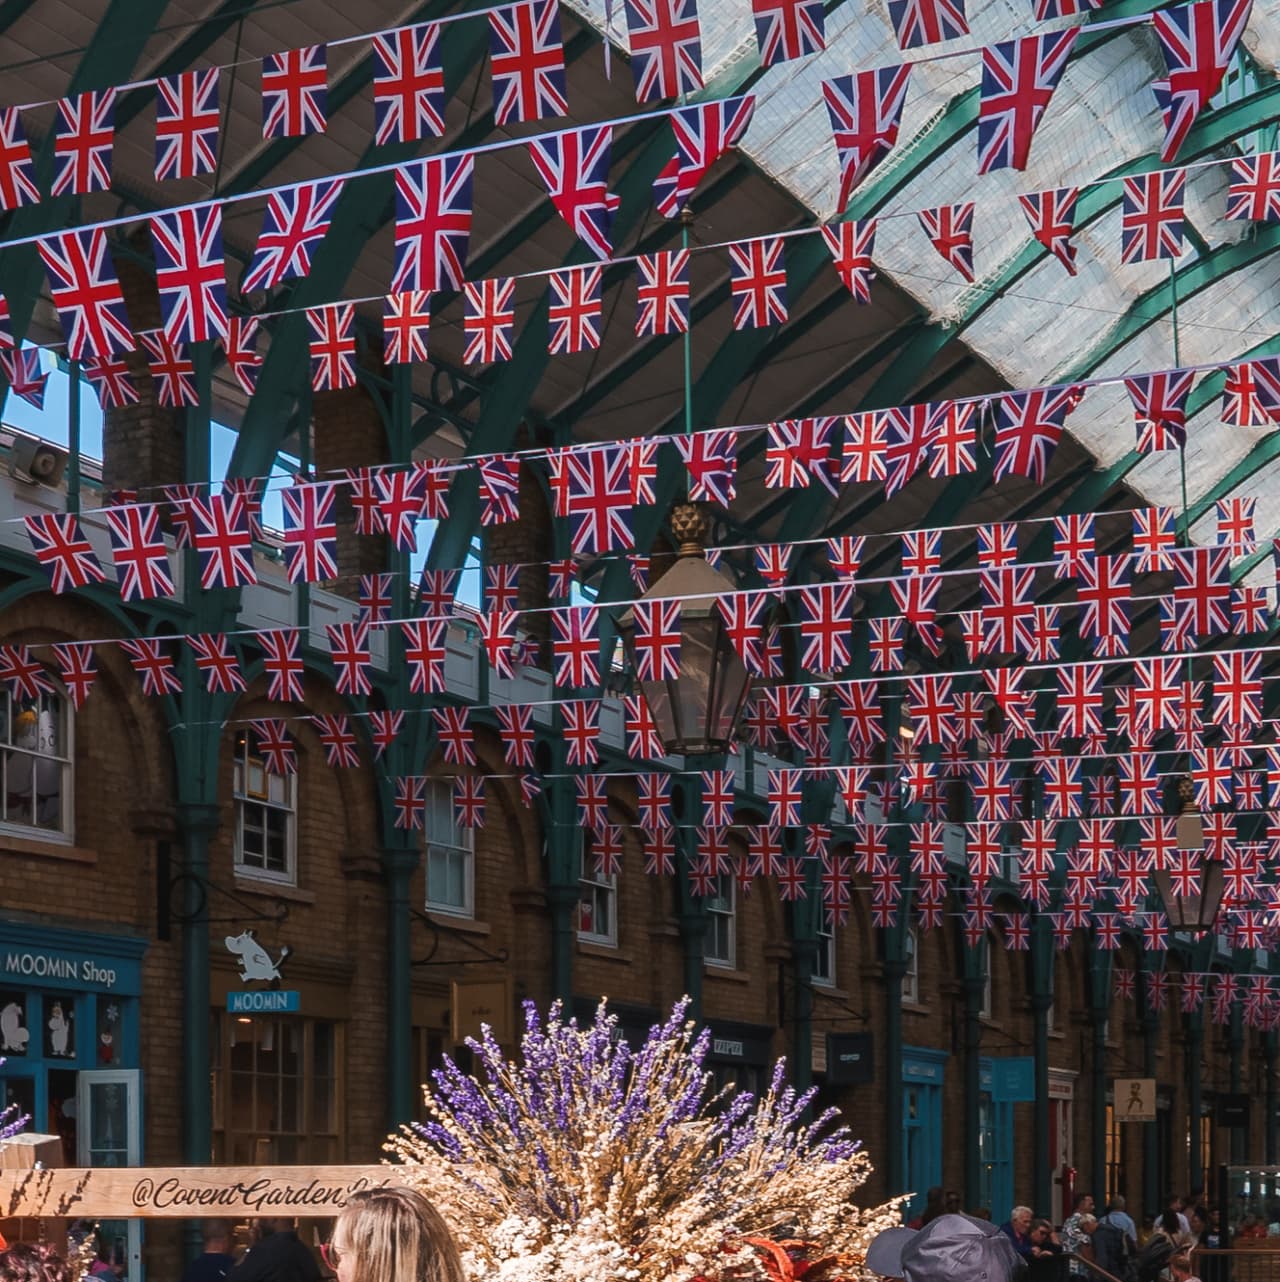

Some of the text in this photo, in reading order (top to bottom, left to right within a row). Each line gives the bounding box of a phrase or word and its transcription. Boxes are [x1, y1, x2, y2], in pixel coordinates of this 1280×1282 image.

[6, 952, 78, 979] MOOMIN
[82, 960, 116, 987] Shop
[233, 992, 287, 1010] MOOMIN
